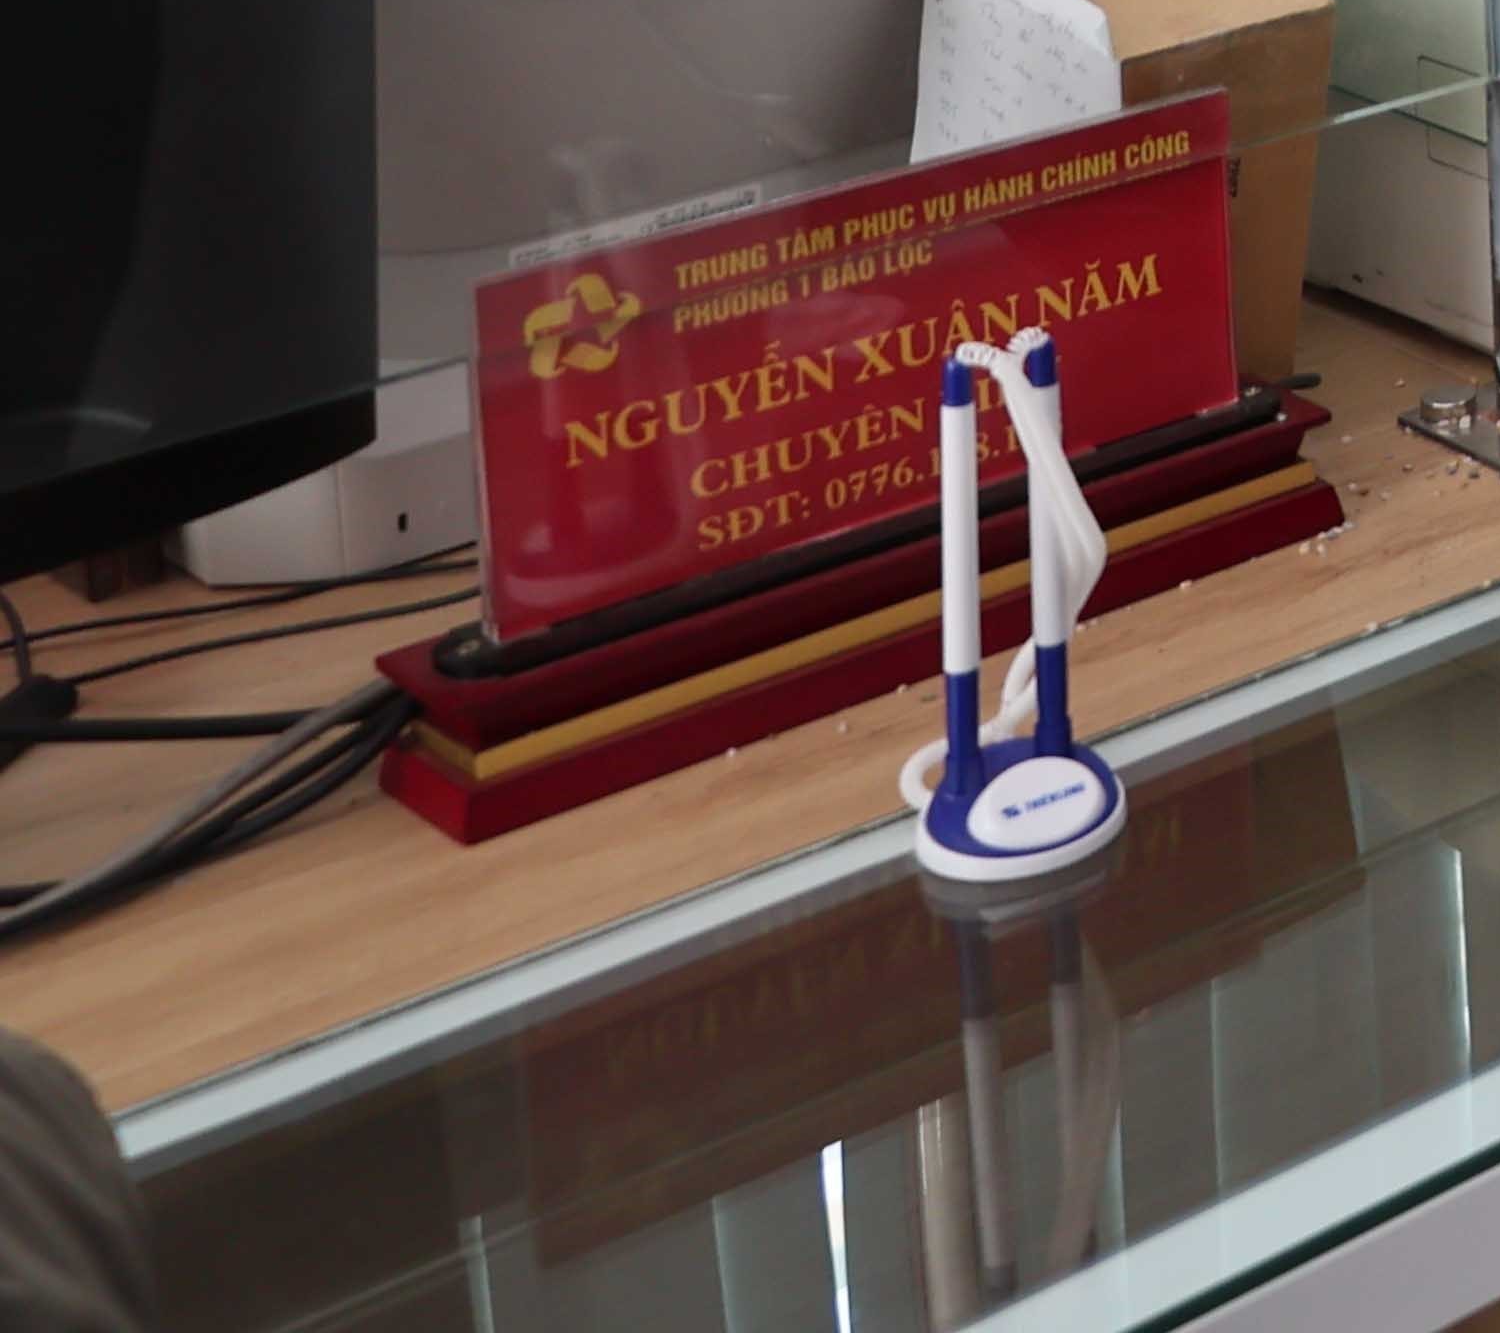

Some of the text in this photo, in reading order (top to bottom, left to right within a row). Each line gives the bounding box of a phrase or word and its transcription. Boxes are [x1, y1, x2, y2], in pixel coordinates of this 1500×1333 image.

[675, 244, 768, 290] TRUNG
[777, 224, 835, 264] TÂM
[964, 174, 1034, 212] HÀNH
[1041, 149, 1117, 192] CHÍNH
[1124, 130, 1190, 171] CÔNG
[801, 276, 809, 298] 1
[884, 237, 934, 278] LỘC
[564, 254, 1162, 469] NGUYỄN XUÂN NĂM
[690, 398, 927, 498] CHUYÊN
[697, 490, 811, 549] SĐT:
